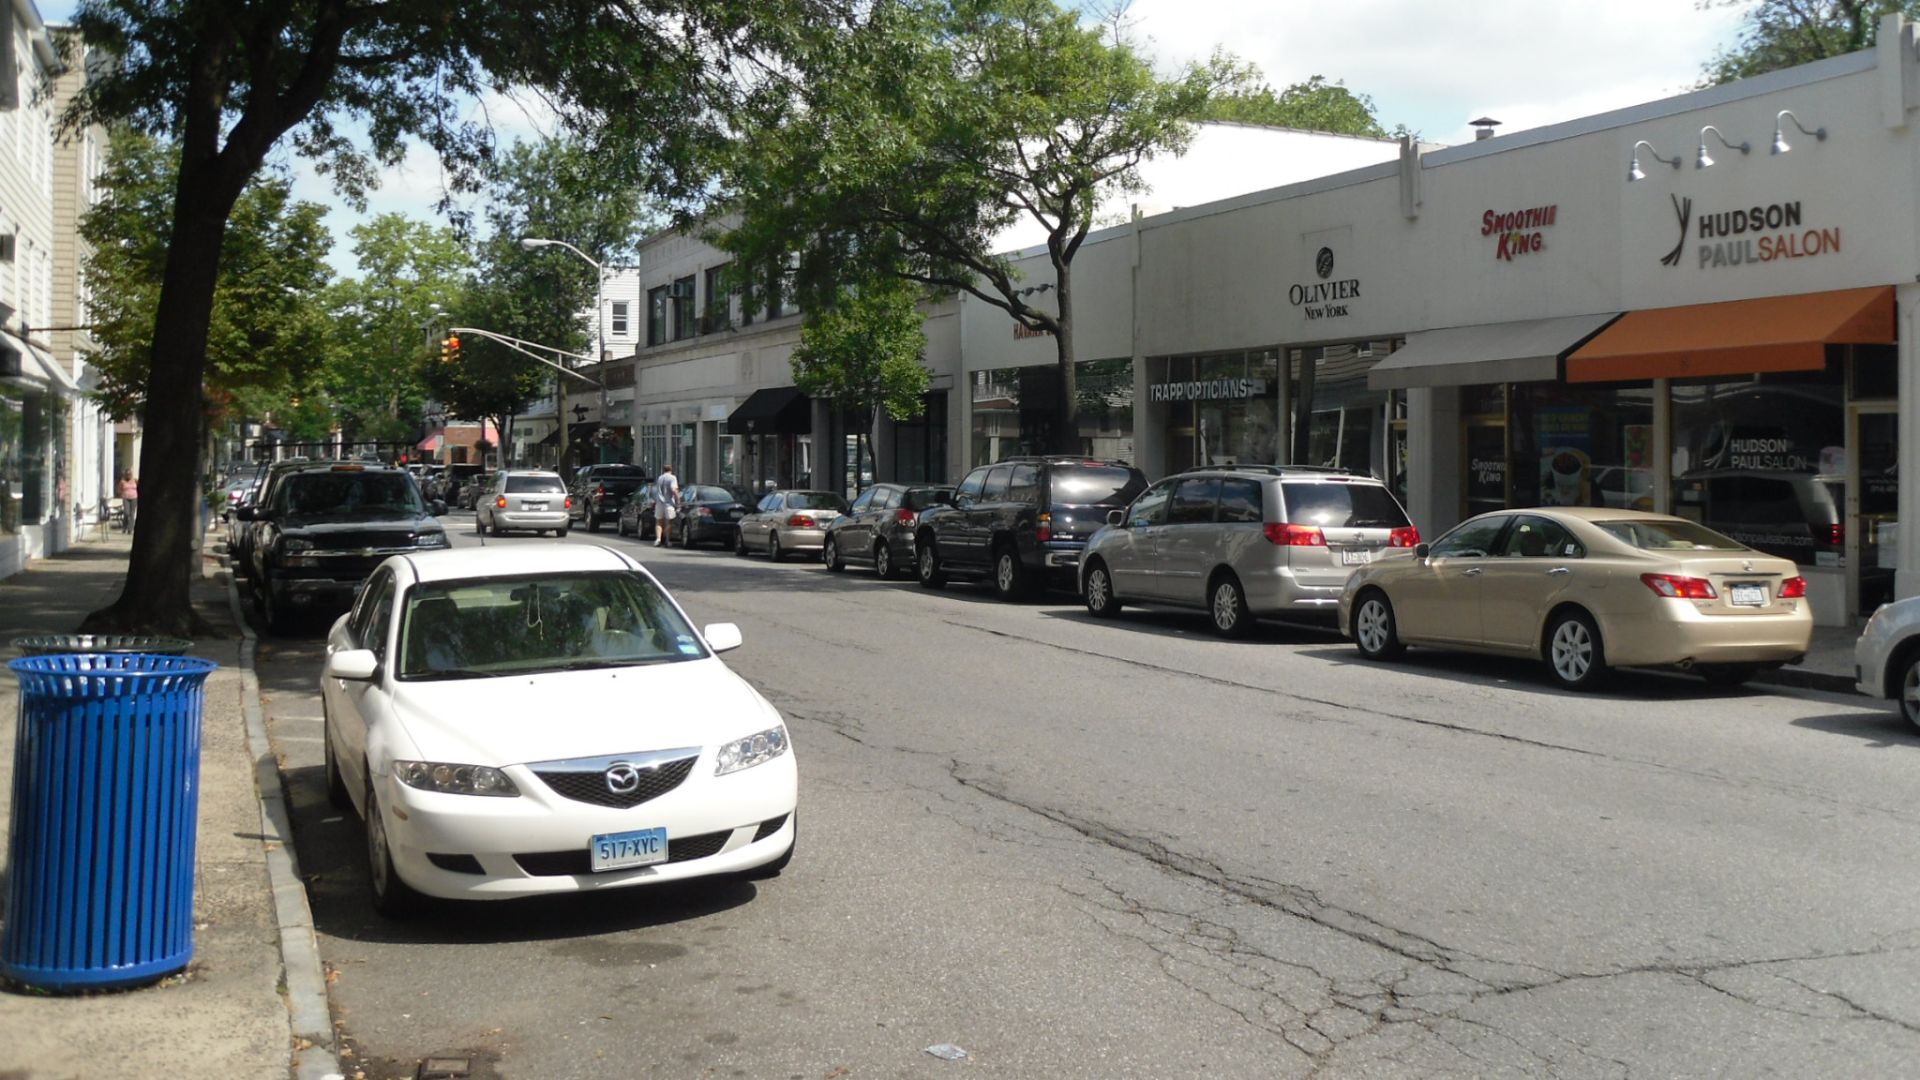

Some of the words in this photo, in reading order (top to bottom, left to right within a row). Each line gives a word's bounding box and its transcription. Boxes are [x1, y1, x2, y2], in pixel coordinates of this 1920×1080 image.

[1481, 204, 1557, 236] SMOOTHIE
[1698, 201, 1801, 239] HUDSON
[1496, 232, 1543, 262] KING
[1289, 278, 1361, 306] OLIVIER
[1304, 306, 1325, 320] NEW
[1324, 303, 1349, 319] YORK
[1186, 378, 1248, 401] OPTICIANS
[1730, 438, 1788, 454] HUDSON
